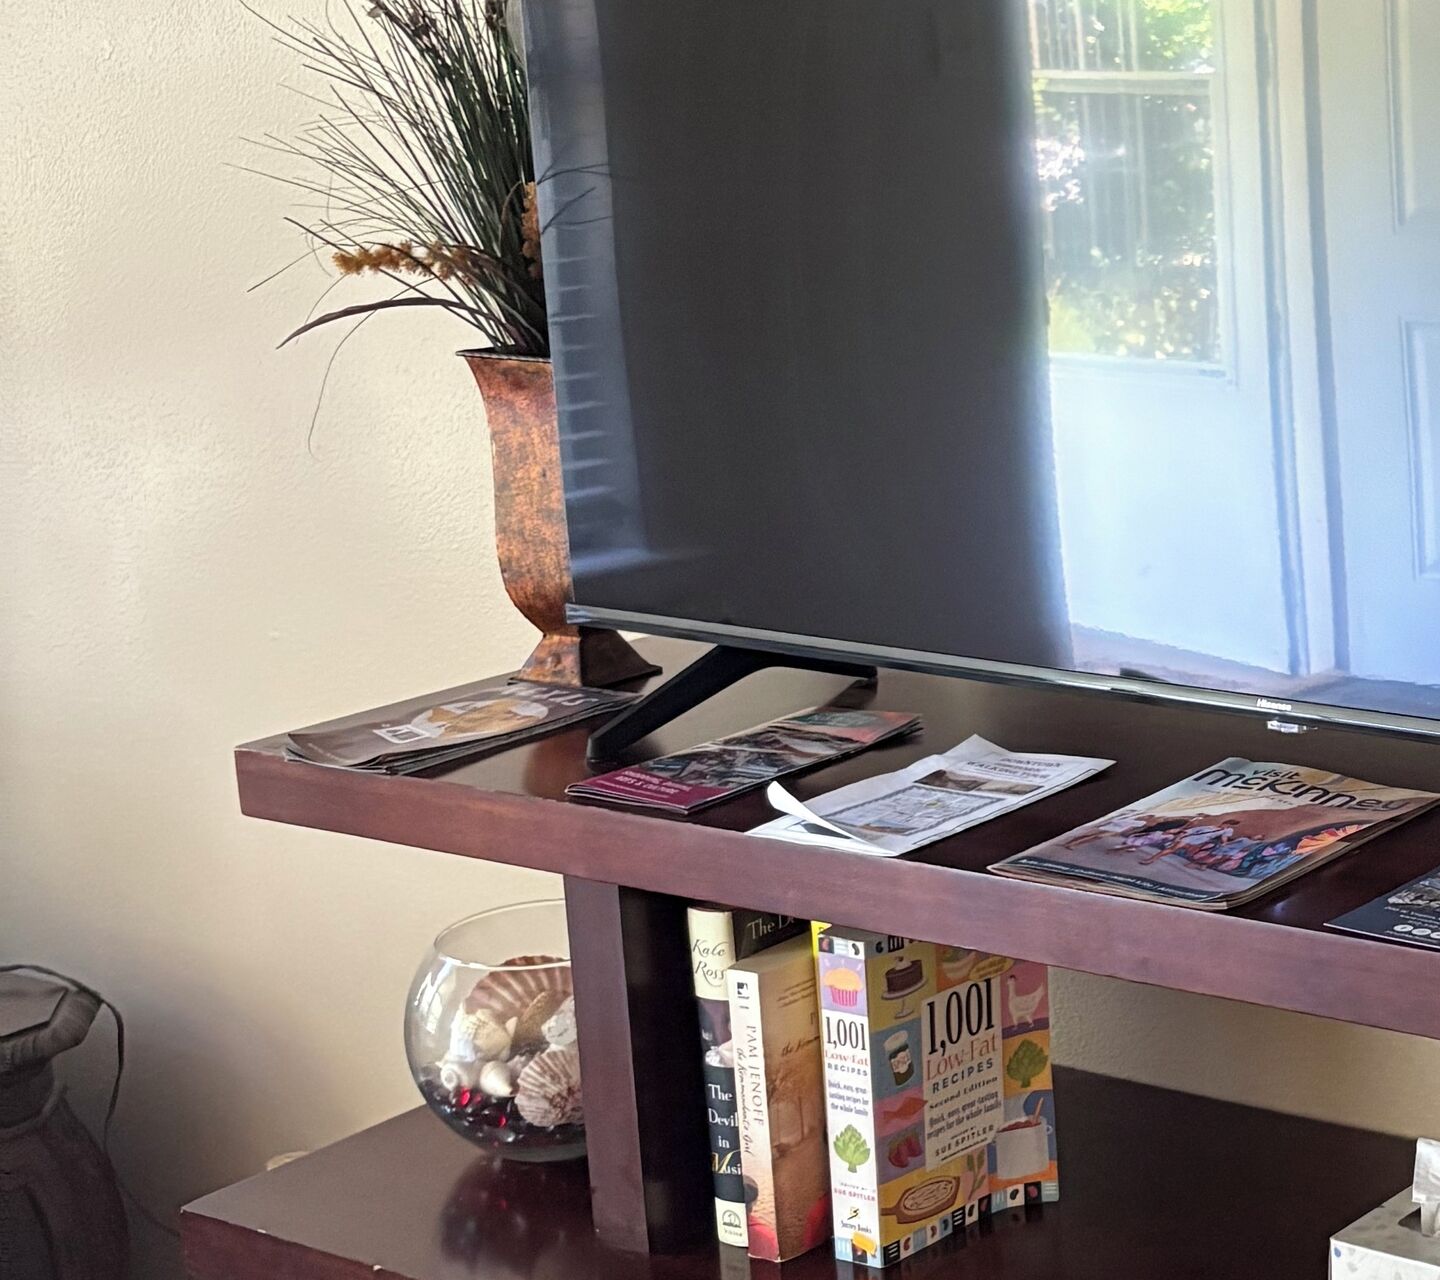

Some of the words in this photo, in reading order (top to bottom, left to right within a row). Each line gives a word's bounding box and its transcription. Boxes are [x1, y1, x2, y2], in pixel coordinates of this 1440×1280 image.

[1252, 768, 1301, 779] visit
[746, 918, 775, 940] The
[694, 960, 726, 988] Ross
[926, 977, 994, 1057] 1,001
[746, 1024, 759, 1058] PAM
[826, 1016, 867, 1052] 1,001
[828, 1062, 868, 1077] RECIPES
[927, 1032, 997, 1081] Low-Fat
[932, 1057, 993, 1095] RECIPES
[708, 1083, 733, 1102] The
[748, 1065, 765, 1127] JENOFF
[929, 1090, 961, 1109] Second
[963, 1076, 998, 1095] Edition
[708, 1107, 739, 1128] Devil
[718, 1135, 730, 1149] in
[935, 1142, 952, 1157] SUE
[954, 1124, 995, 1148] SPITLER
[711, 1149, 742, 1174] Musi
